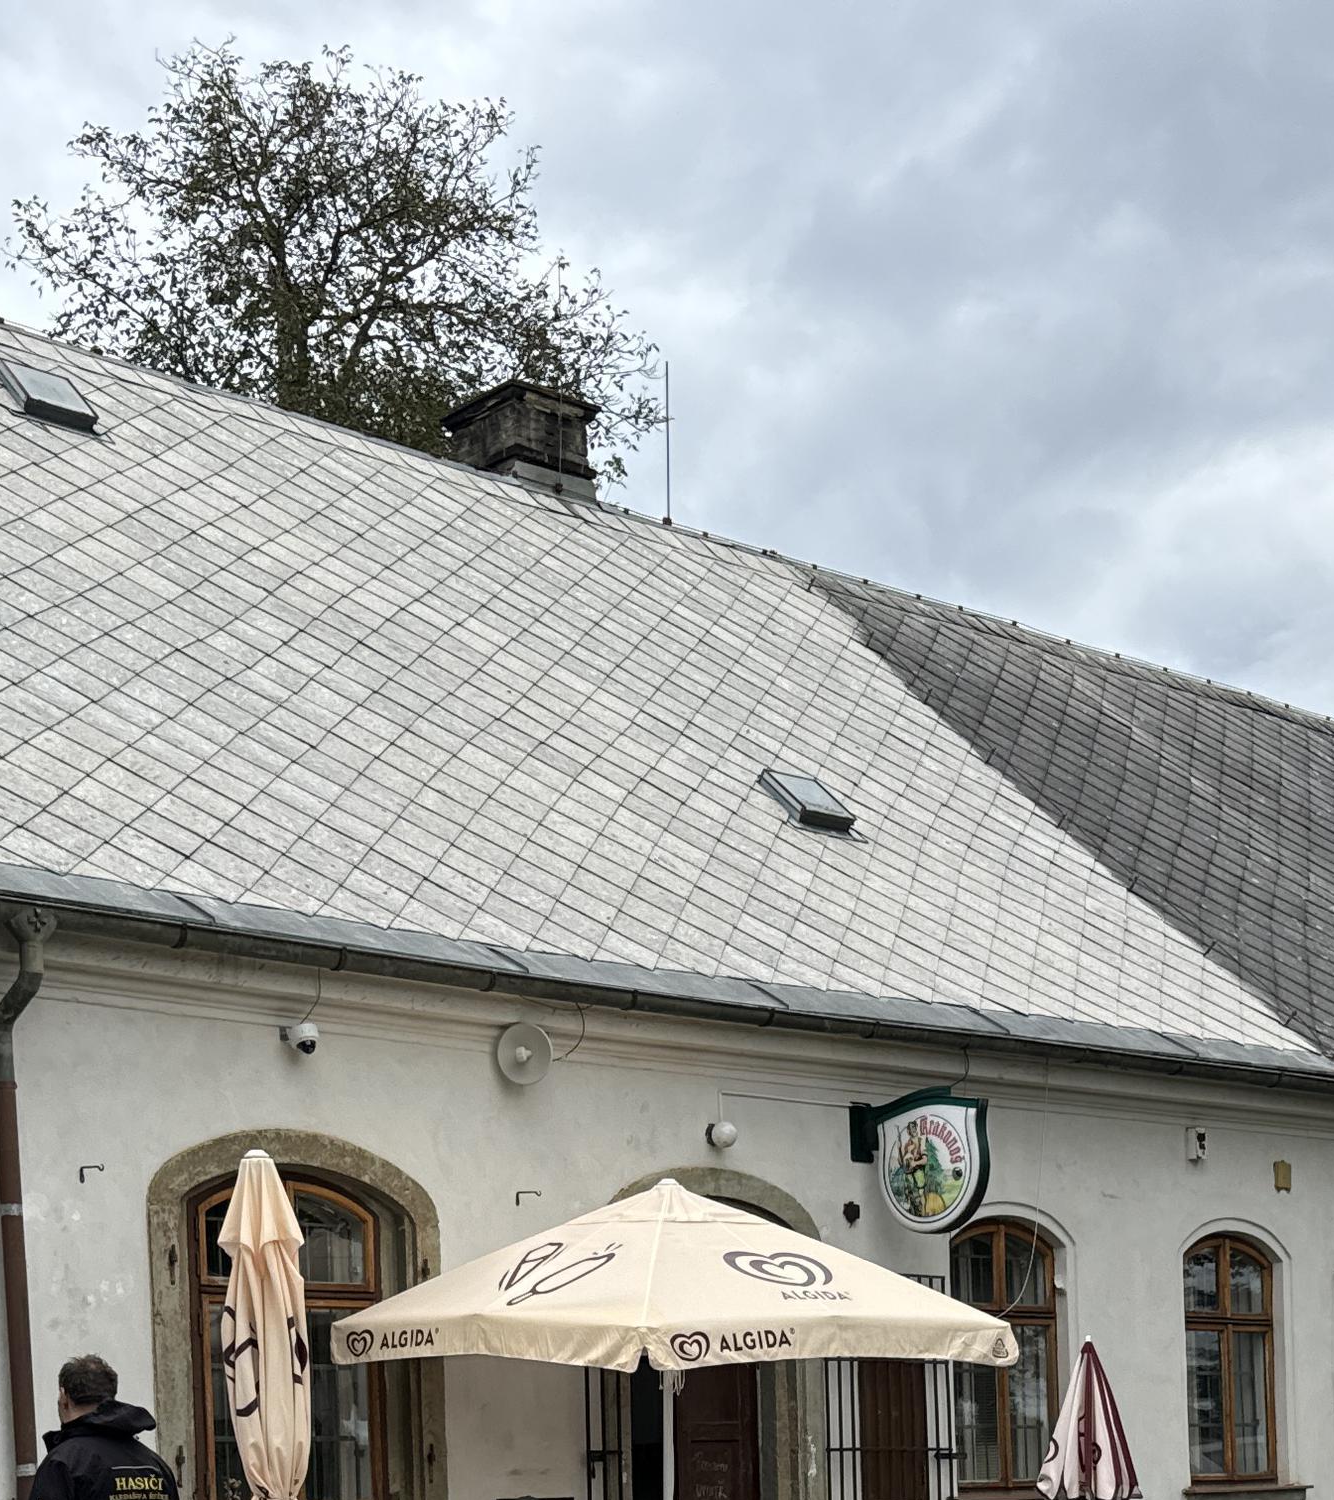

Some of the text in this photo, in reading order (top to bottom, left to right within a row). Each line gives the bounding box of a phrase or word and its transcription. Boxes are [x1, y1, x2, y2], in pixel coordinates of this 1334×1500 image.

[919, 1115, 965, 1164] Krakonoš
[380, 1328, 434, 1350] ALGIDA
[720, 1329, 792, 1352] ALGIDA
[114, 1474, 164, 1490] HASIČI
